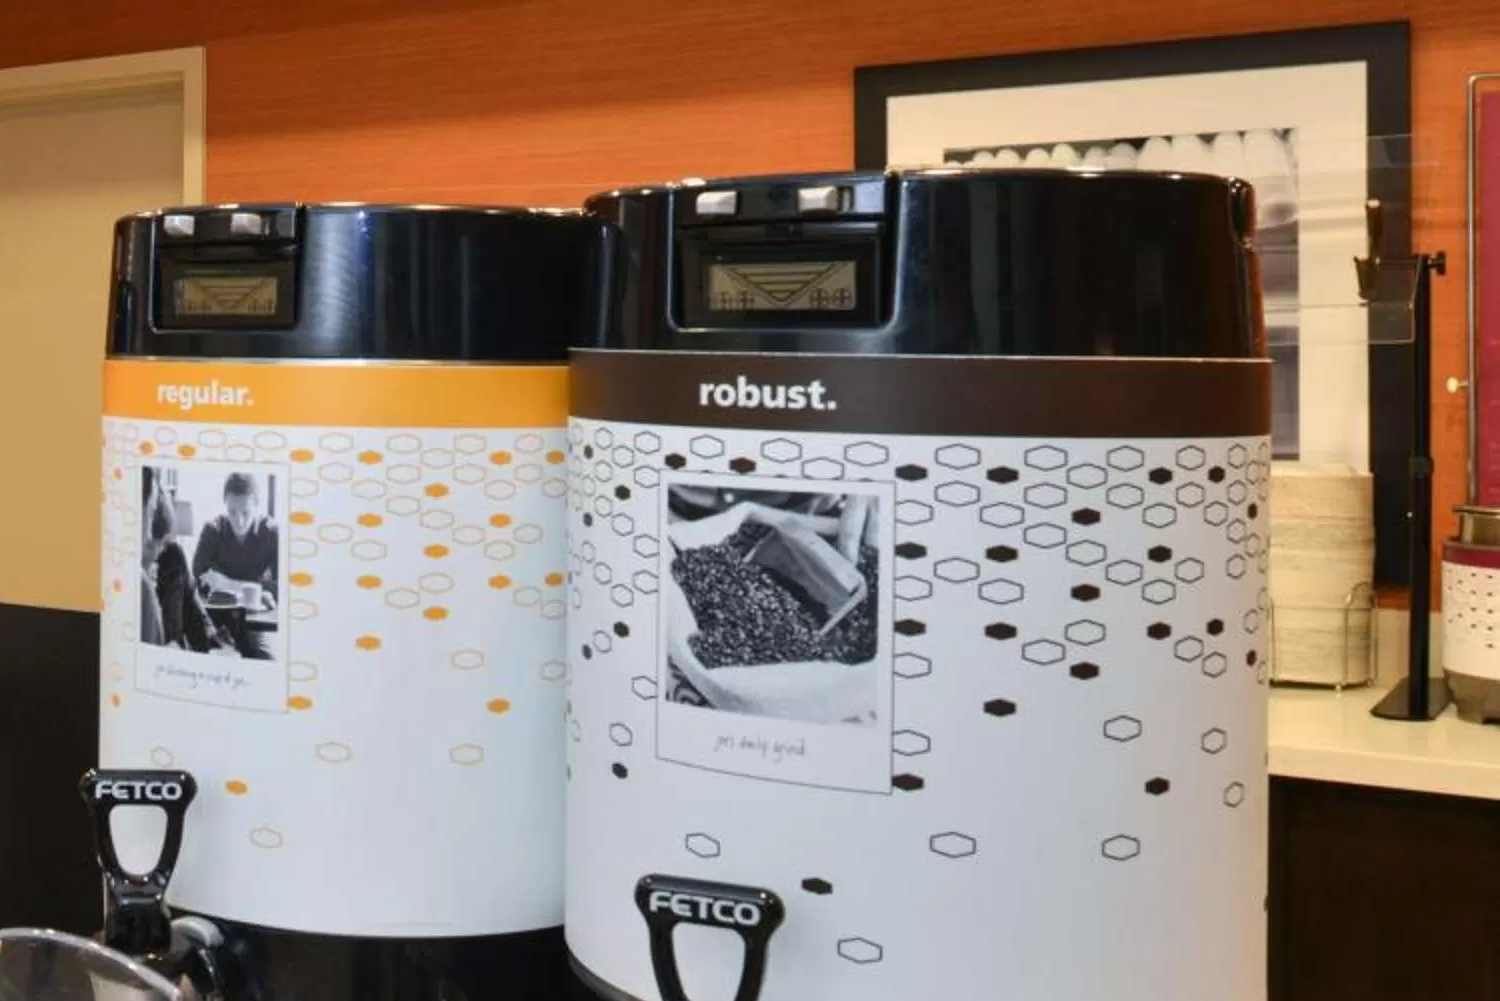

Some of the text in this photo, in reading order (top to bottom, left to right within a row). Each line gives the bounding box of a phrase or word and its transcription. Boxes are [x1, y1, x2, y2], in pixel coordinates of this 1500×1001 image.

[157, 379, 254, 410] regular.
[699, 375, 837, 410] robust.
[95, 780, 182, 801] FETCO
[649, 891, 761, 927] FETCO
